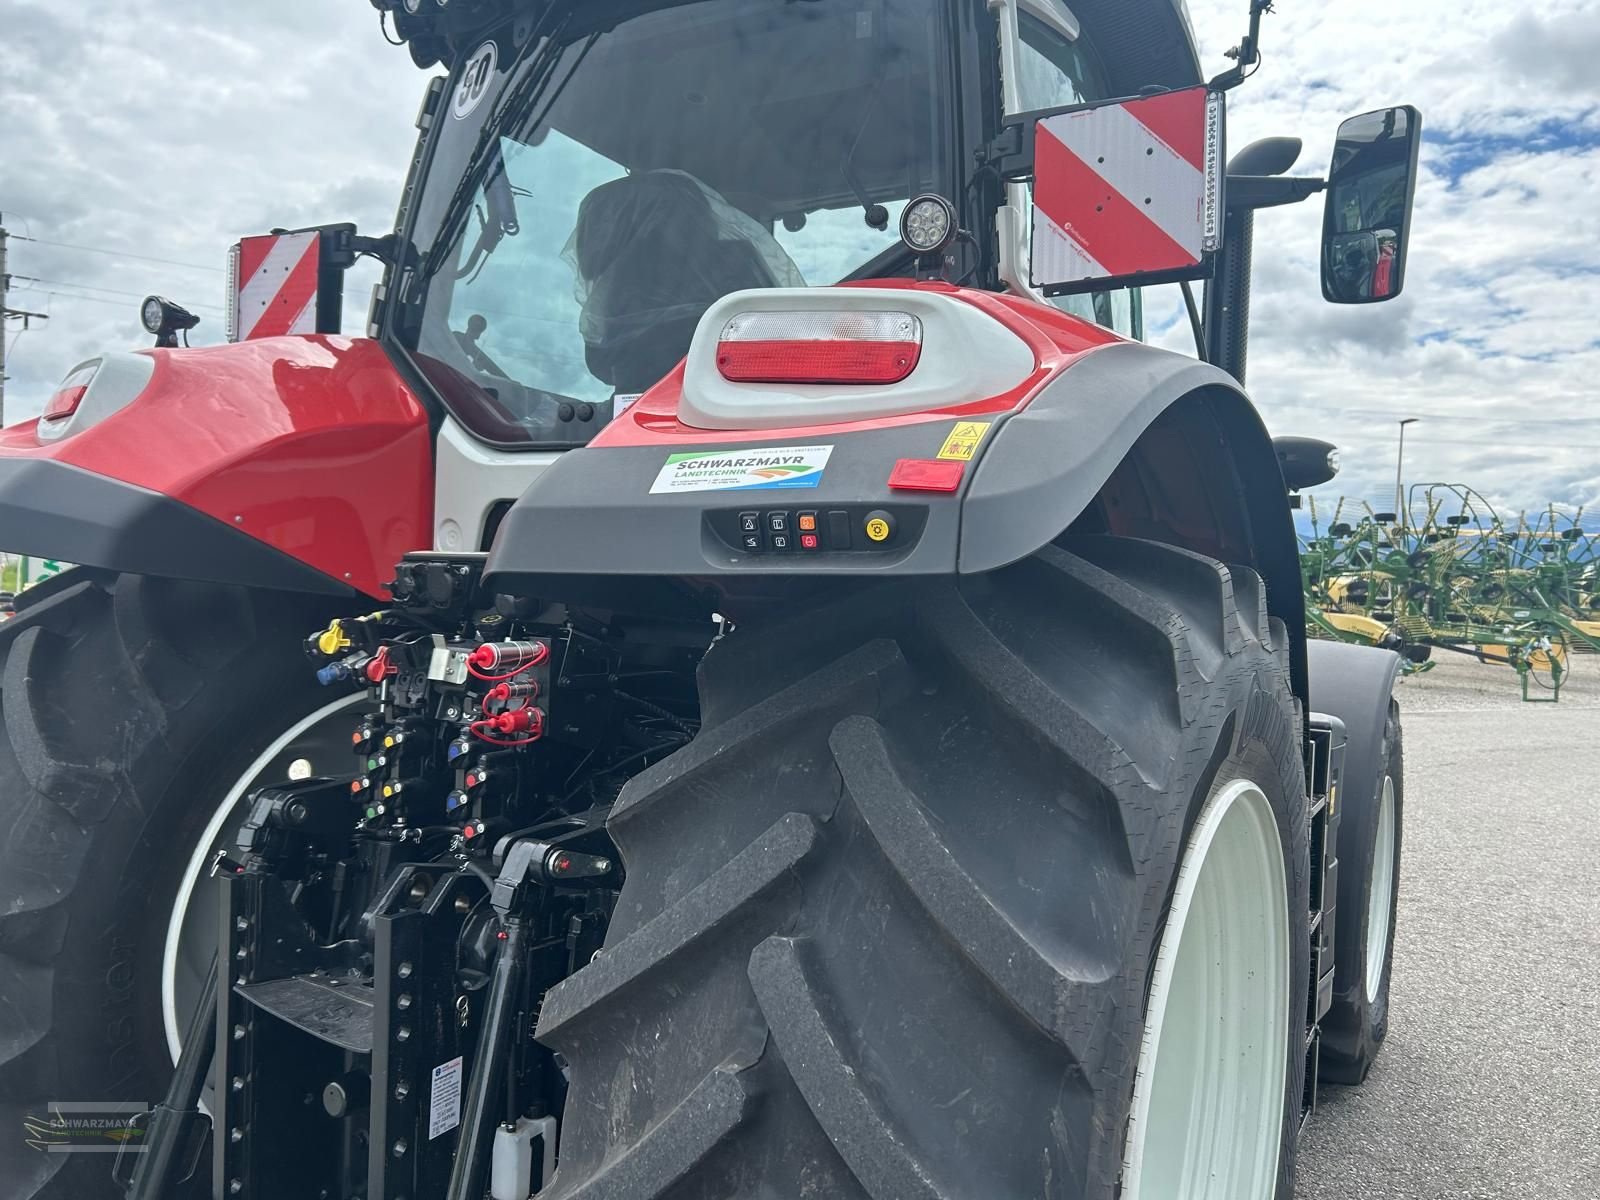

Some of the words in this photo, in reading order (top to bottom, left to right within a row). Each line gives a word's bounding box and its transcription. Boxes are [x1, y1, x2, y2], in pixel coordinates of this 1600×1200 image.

[457, 51, 493, 108] 50
[676, 456, 805, 470] SCHWARZMAYR
[674, 468, 748, 478] LANDTECHNIK
